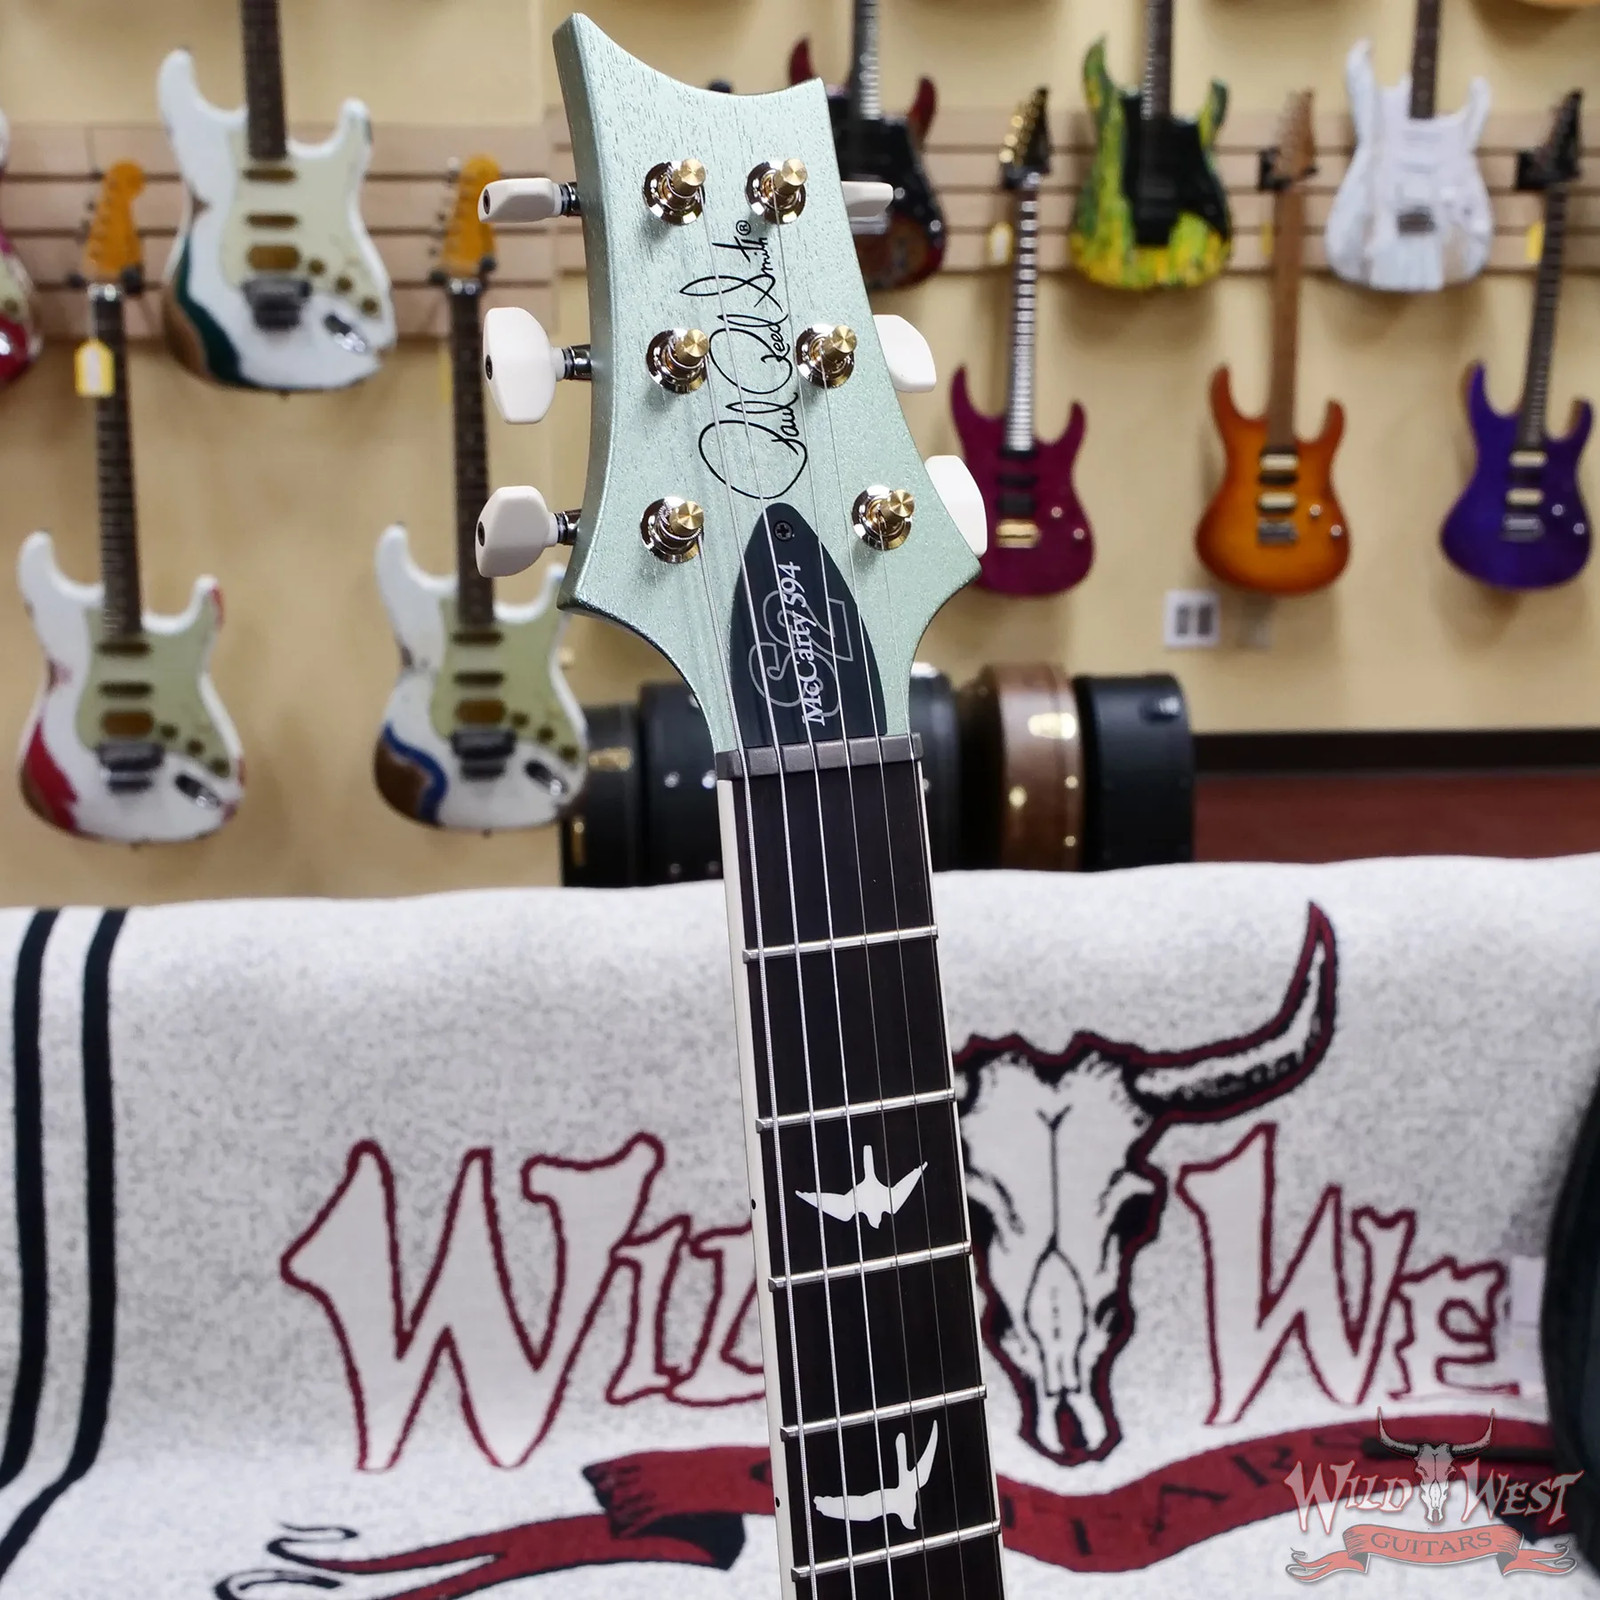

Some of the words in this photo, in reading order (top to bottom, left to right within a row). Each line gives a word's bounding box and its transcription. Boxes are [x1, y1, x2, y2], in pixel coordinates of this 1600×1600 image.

[708, 313, 793, 395] Reed
[699, 392, 808, 500] Paul
[778, 561, 807, 609] 594
[791, 609, 826, 727] McCarty
[280, 1131, 767, 1475] WIL
